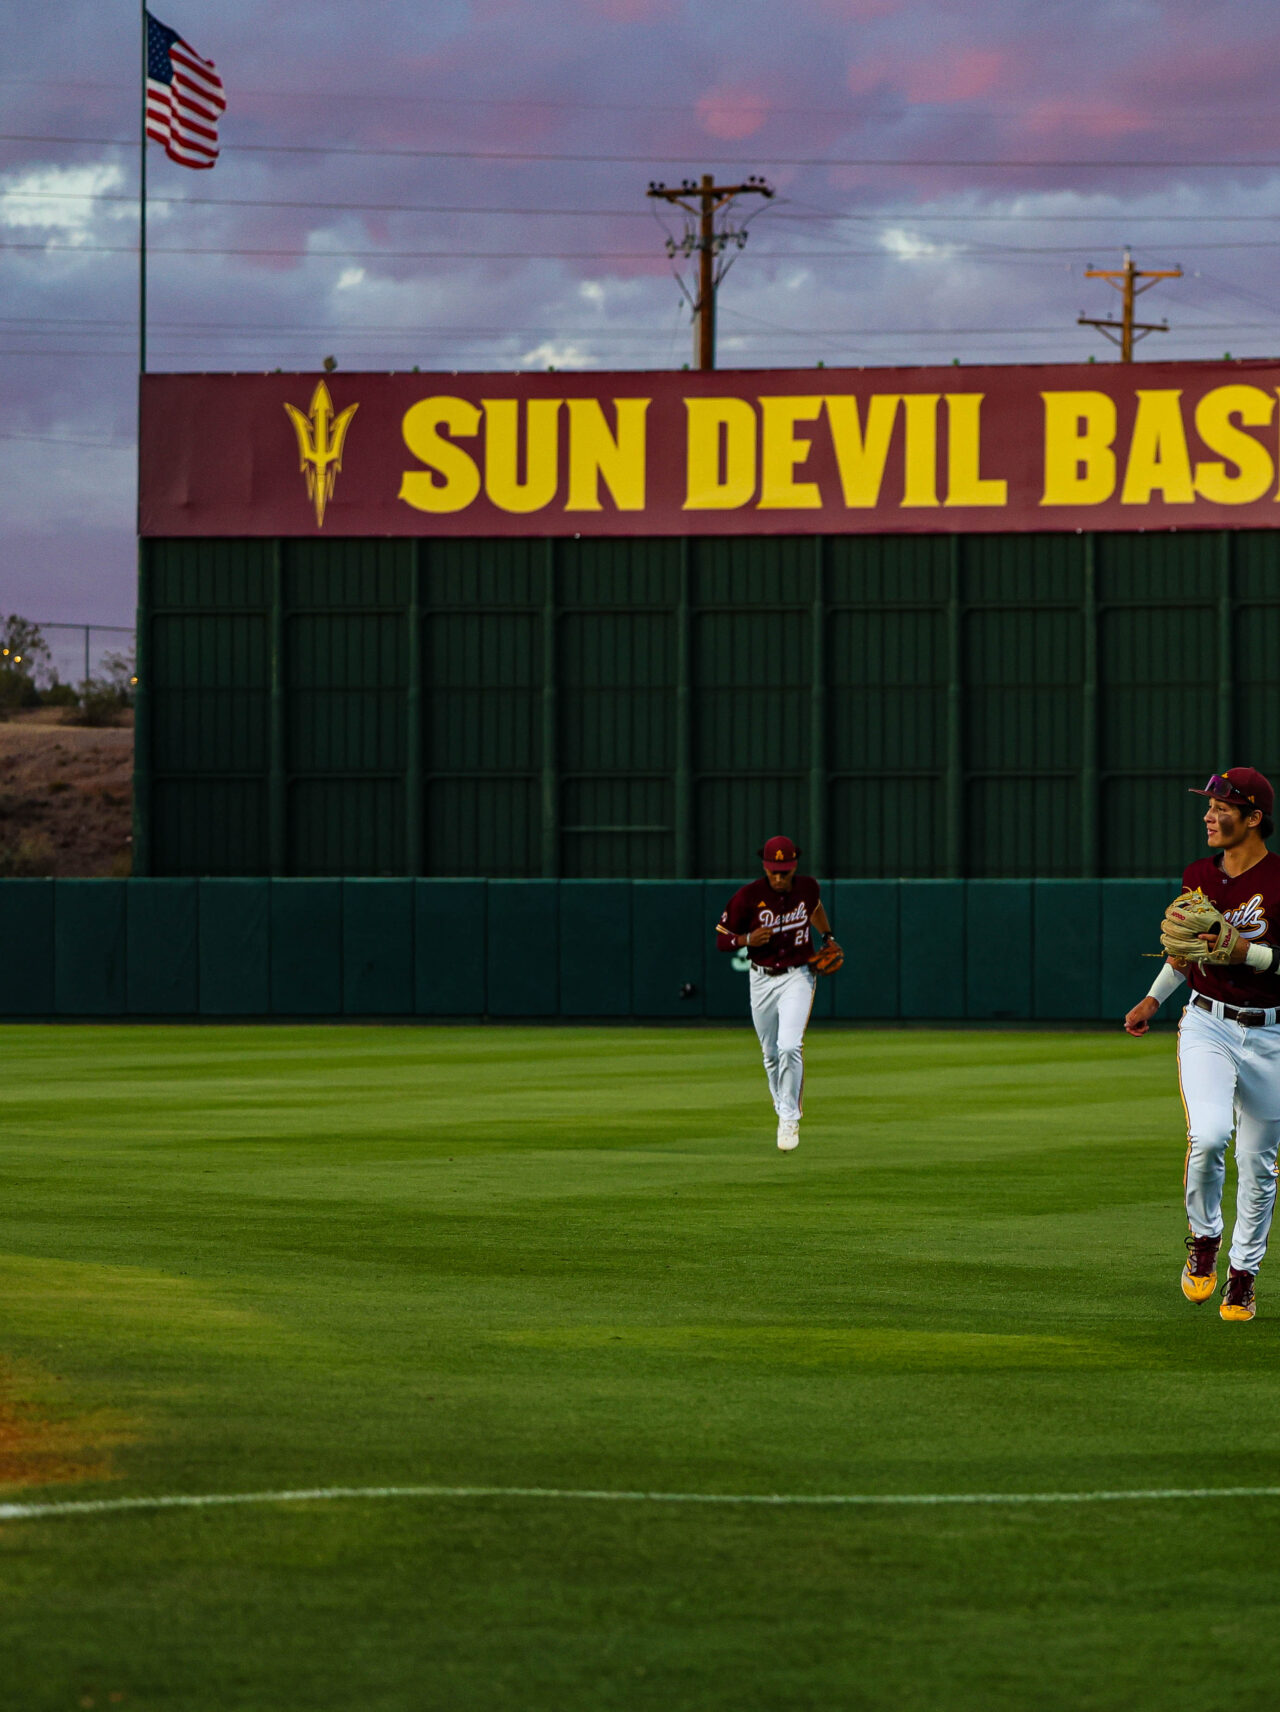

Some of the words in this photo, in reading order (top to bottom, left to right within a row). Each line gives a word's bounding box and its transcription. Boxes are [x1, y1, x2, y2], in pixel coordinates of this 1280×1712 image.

[398, 395, 652, 513] SUN
[682, 392, 1007, 511] DEVIL
[795, 926, 809, 946] 24
